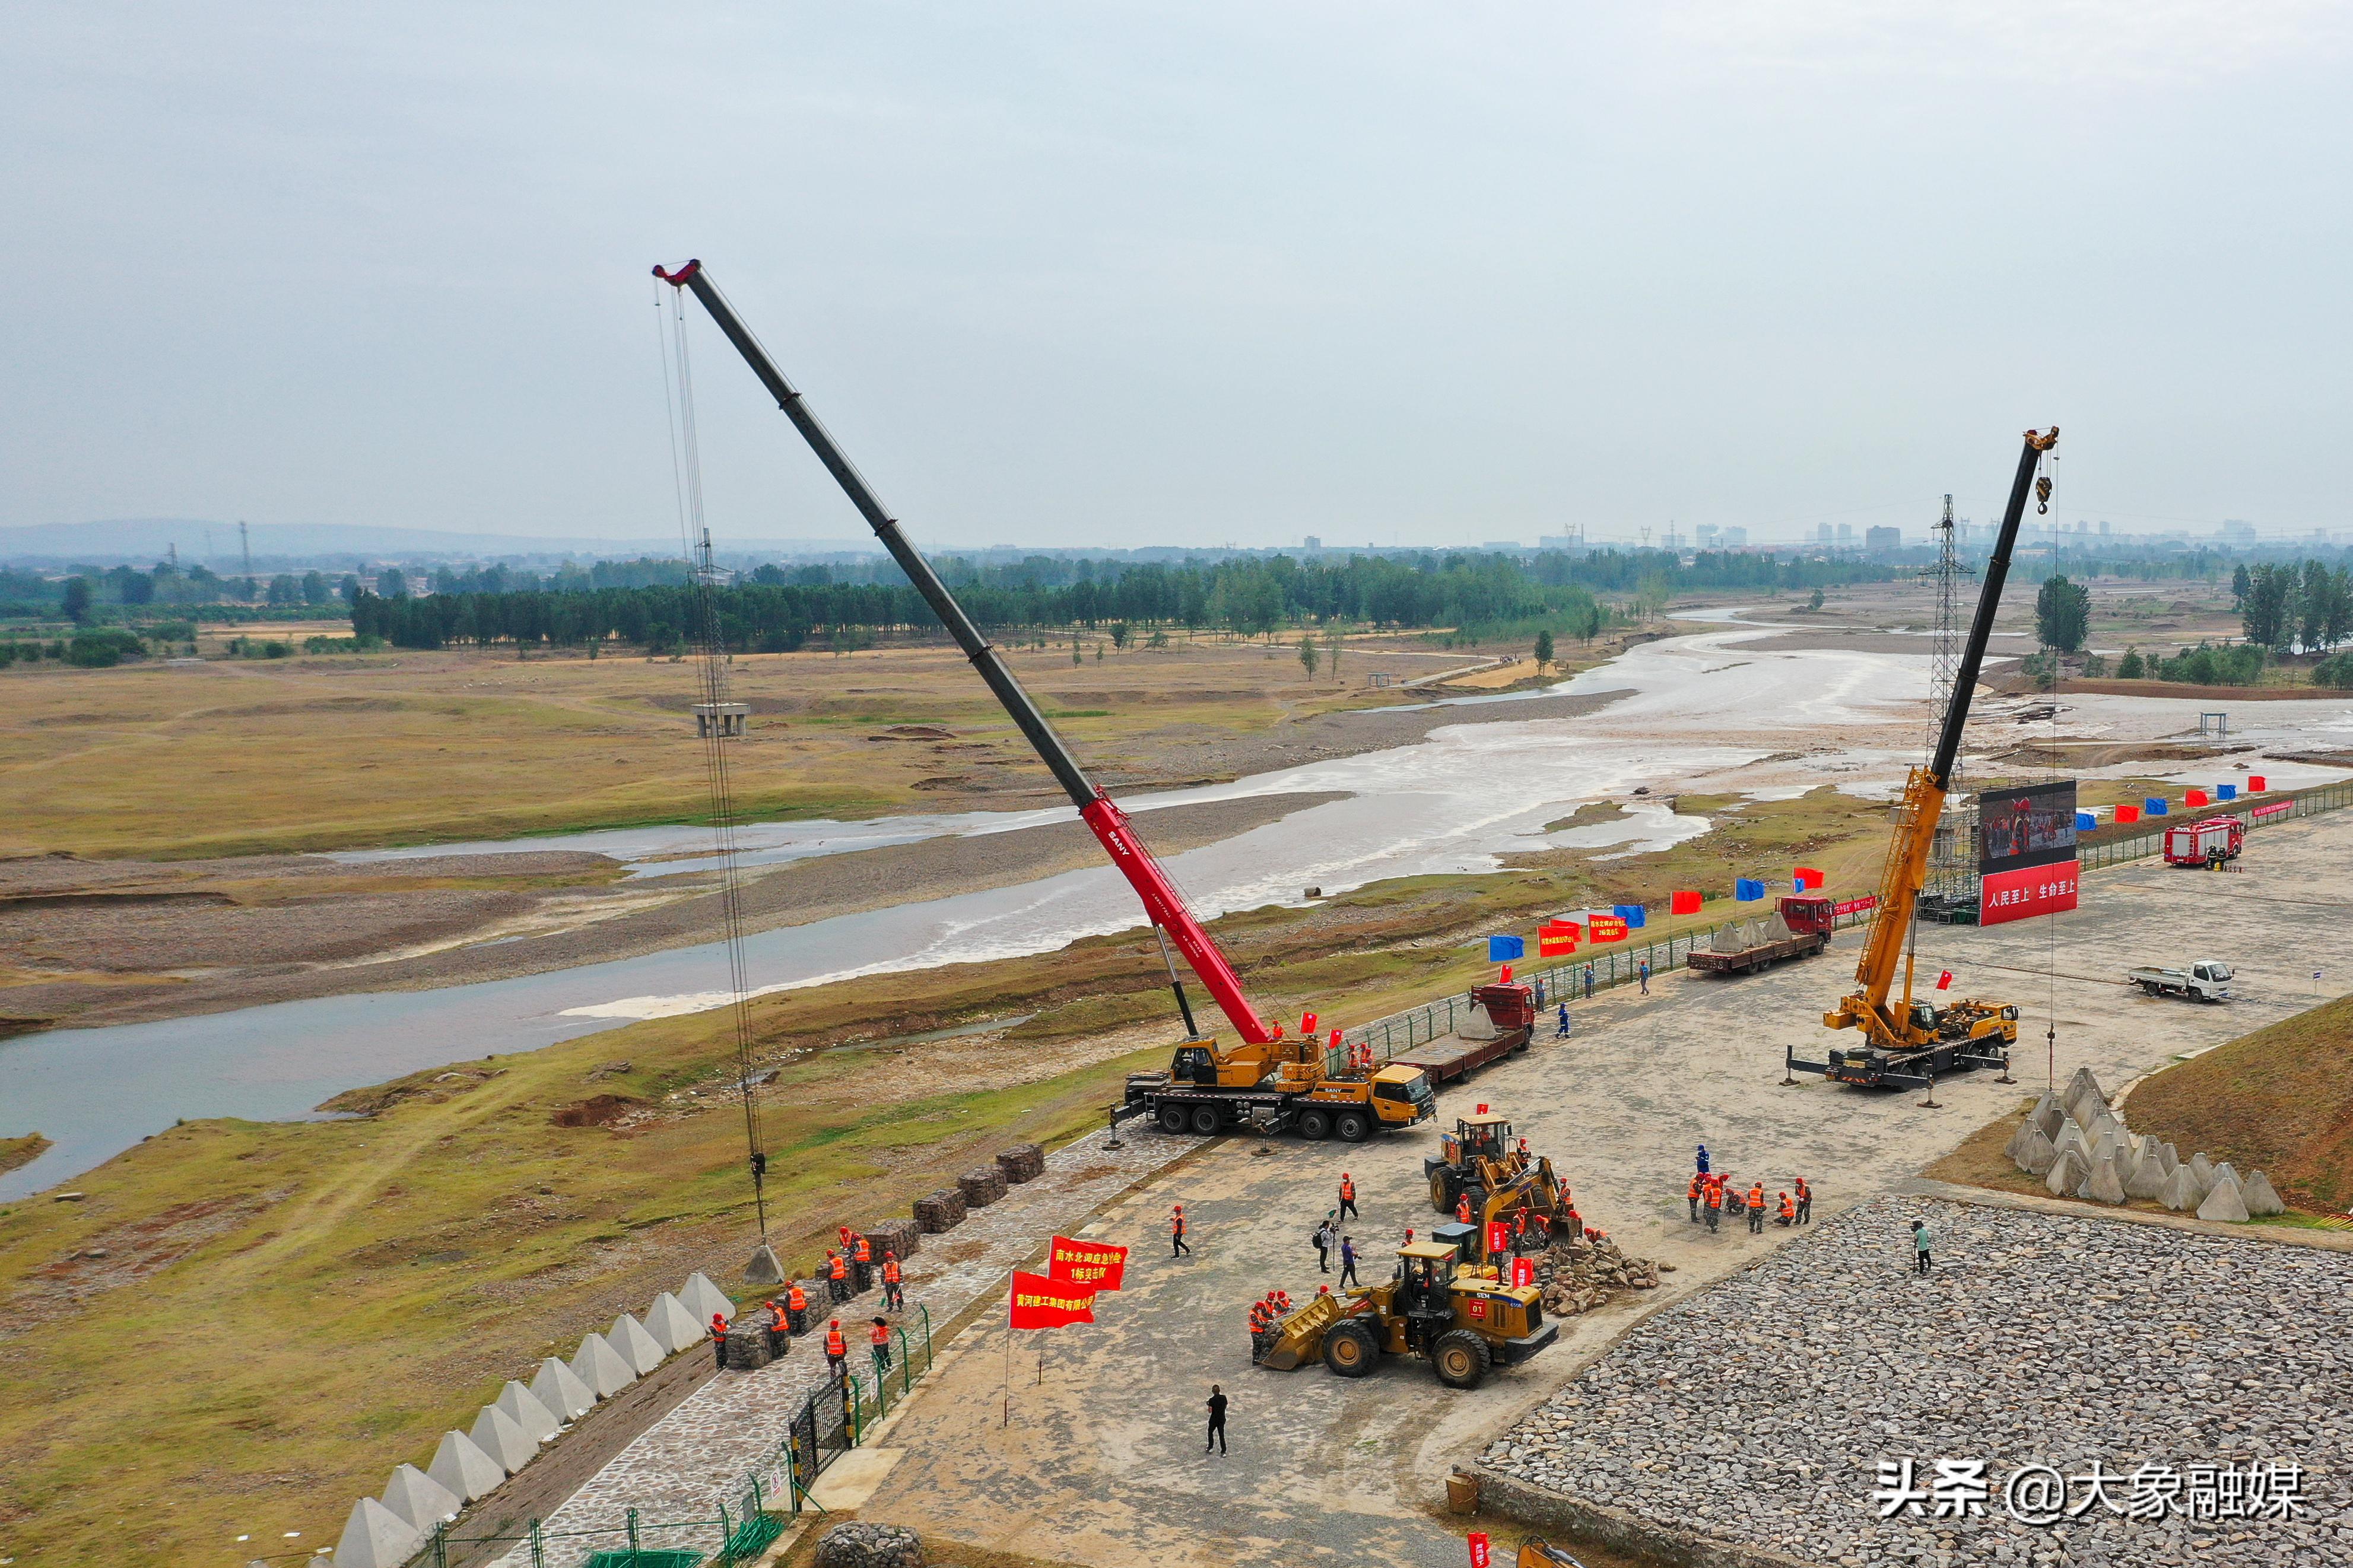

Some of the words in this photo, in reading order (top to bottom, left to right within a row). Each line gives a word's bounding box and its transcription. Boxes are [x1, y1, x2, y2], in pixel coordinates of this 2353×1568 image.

[1108, 831, 1130, 855] SANY
[1988, 887, 2030, 908] 人民至上
[2038, 879, 2075, 899] 生命至上
[1017, 1294, 1094, 1312] 黄河建工集团有限公司
